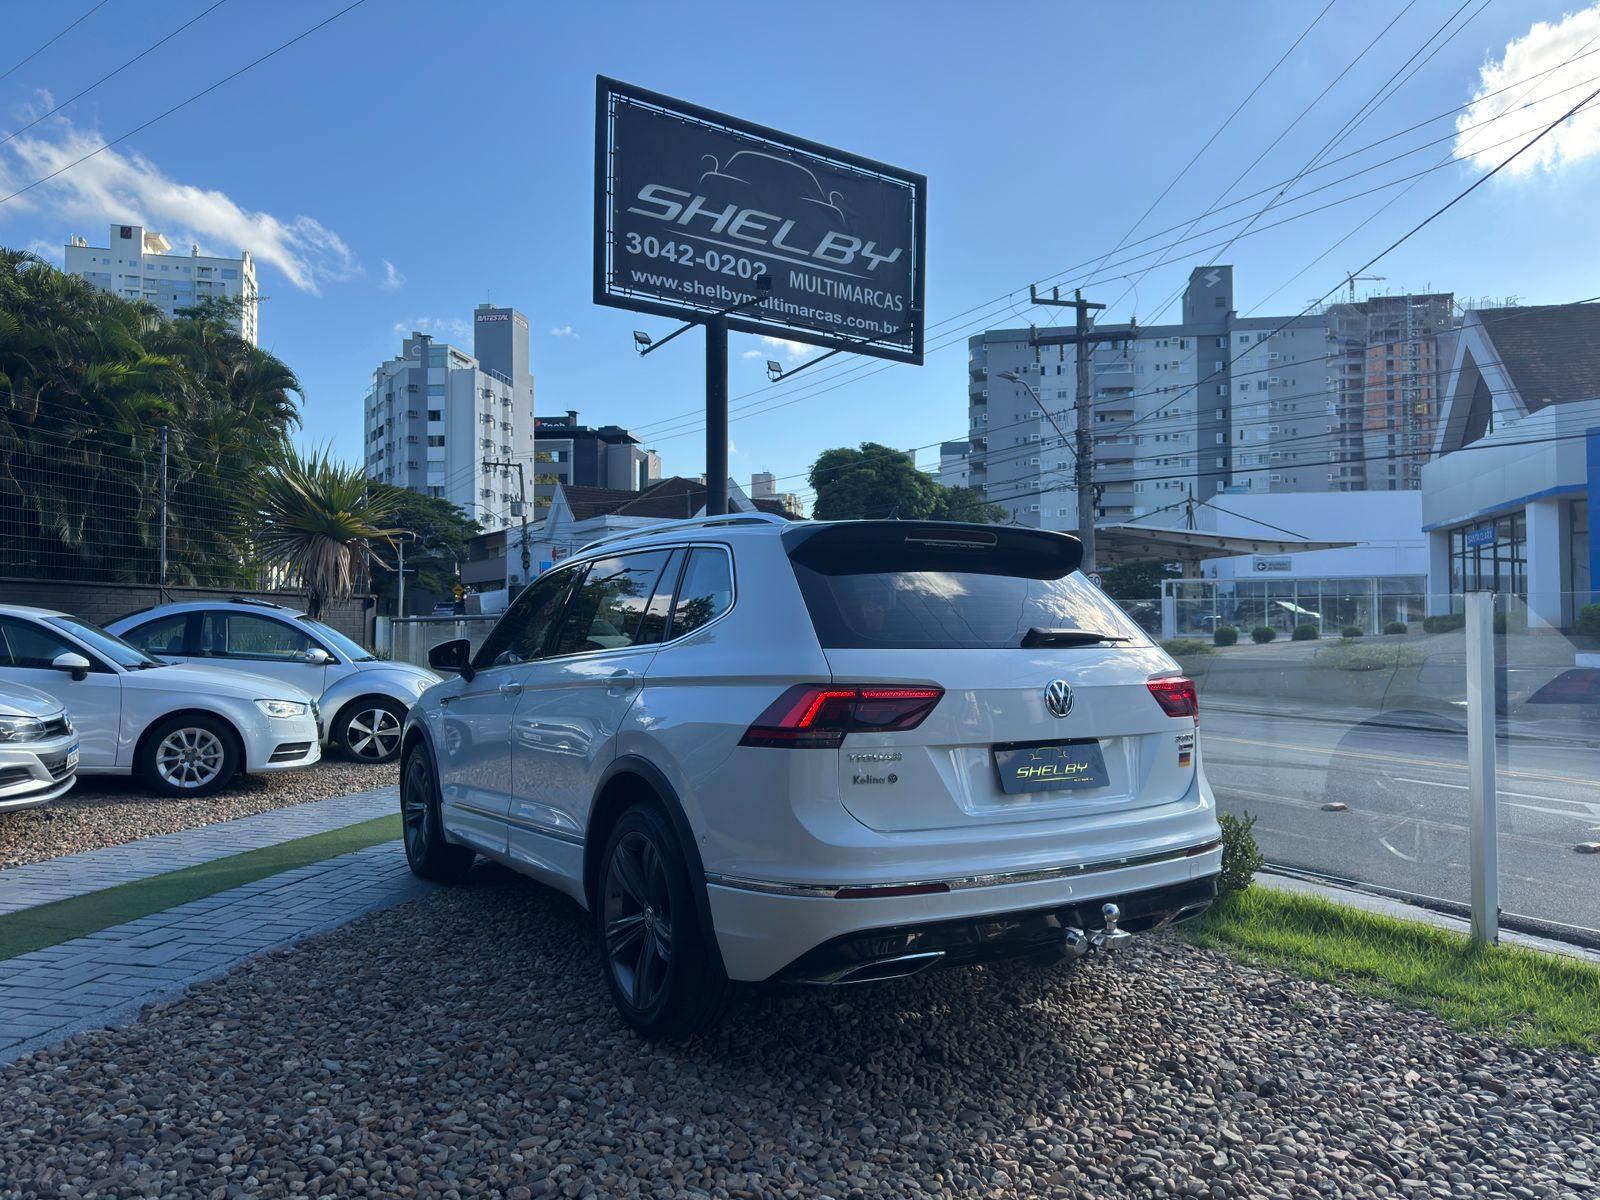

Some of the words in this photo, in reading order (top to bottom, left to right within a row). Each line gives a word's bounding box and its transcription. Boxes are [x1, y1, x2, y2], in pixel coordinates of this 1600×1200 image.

[627, 184, 903, 271] SHELBY
[625, 231, 767, 280] 3042-0202
[631, 269, 900, 335] www.shelbymultimarcas.com.br
[789, 270, 903, 312] MULTIMARCAS
[1016, 763, 1088, 779] SHELBY
